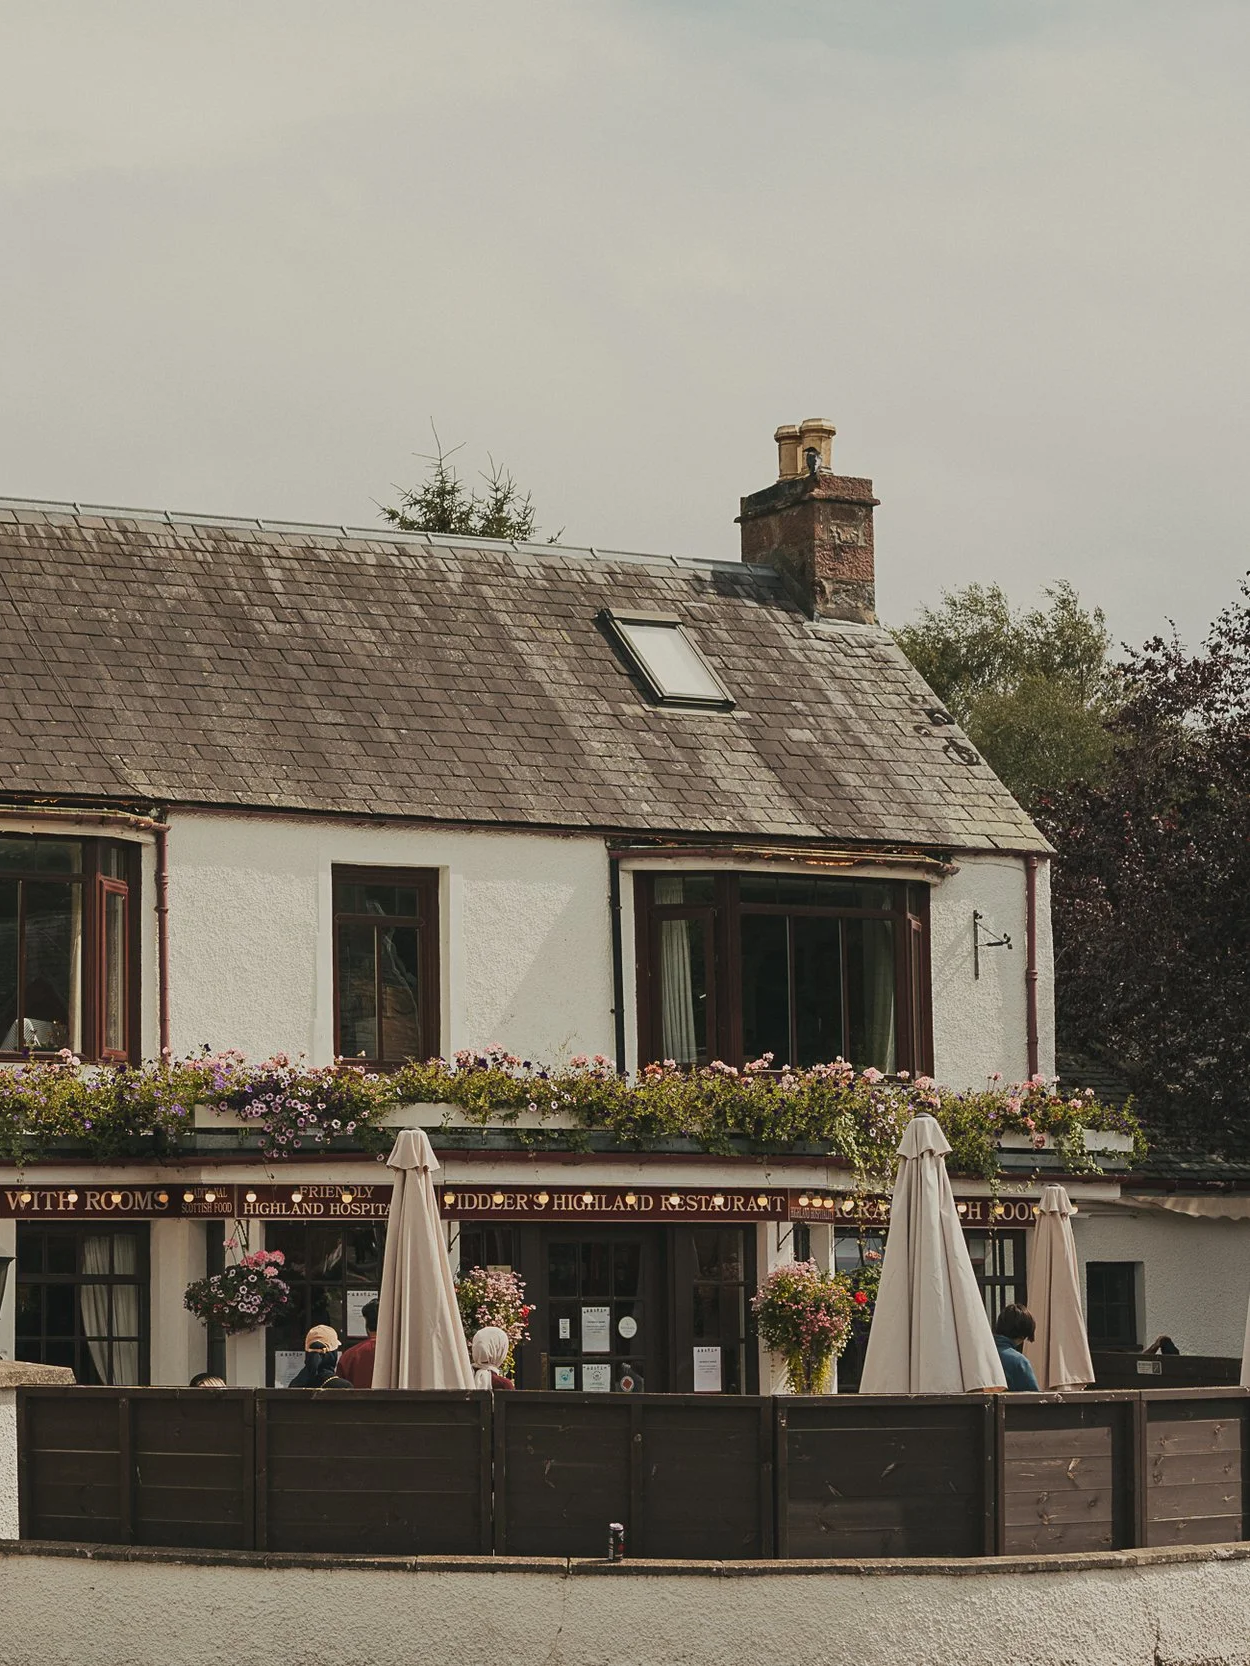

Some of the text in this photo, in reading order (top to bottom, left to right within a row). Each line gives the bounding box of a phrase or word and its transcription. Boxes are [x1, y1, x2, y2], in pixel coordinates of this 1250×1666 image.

[299, 1186, 375, 1198] FRIENDLY
[4, 1190, 77, 1211] WITH
[84, 1190, 169, 1211] ROOMS
[552, 1194, 654, 1211] HIGHLAND
[660, 1194, 786, 1212] RESTAURANT
[181, 1202, 233, 1214] SCOTTISH FOOD
[243, 1202, 391, 1216] HIGHLAND HOSPITA
